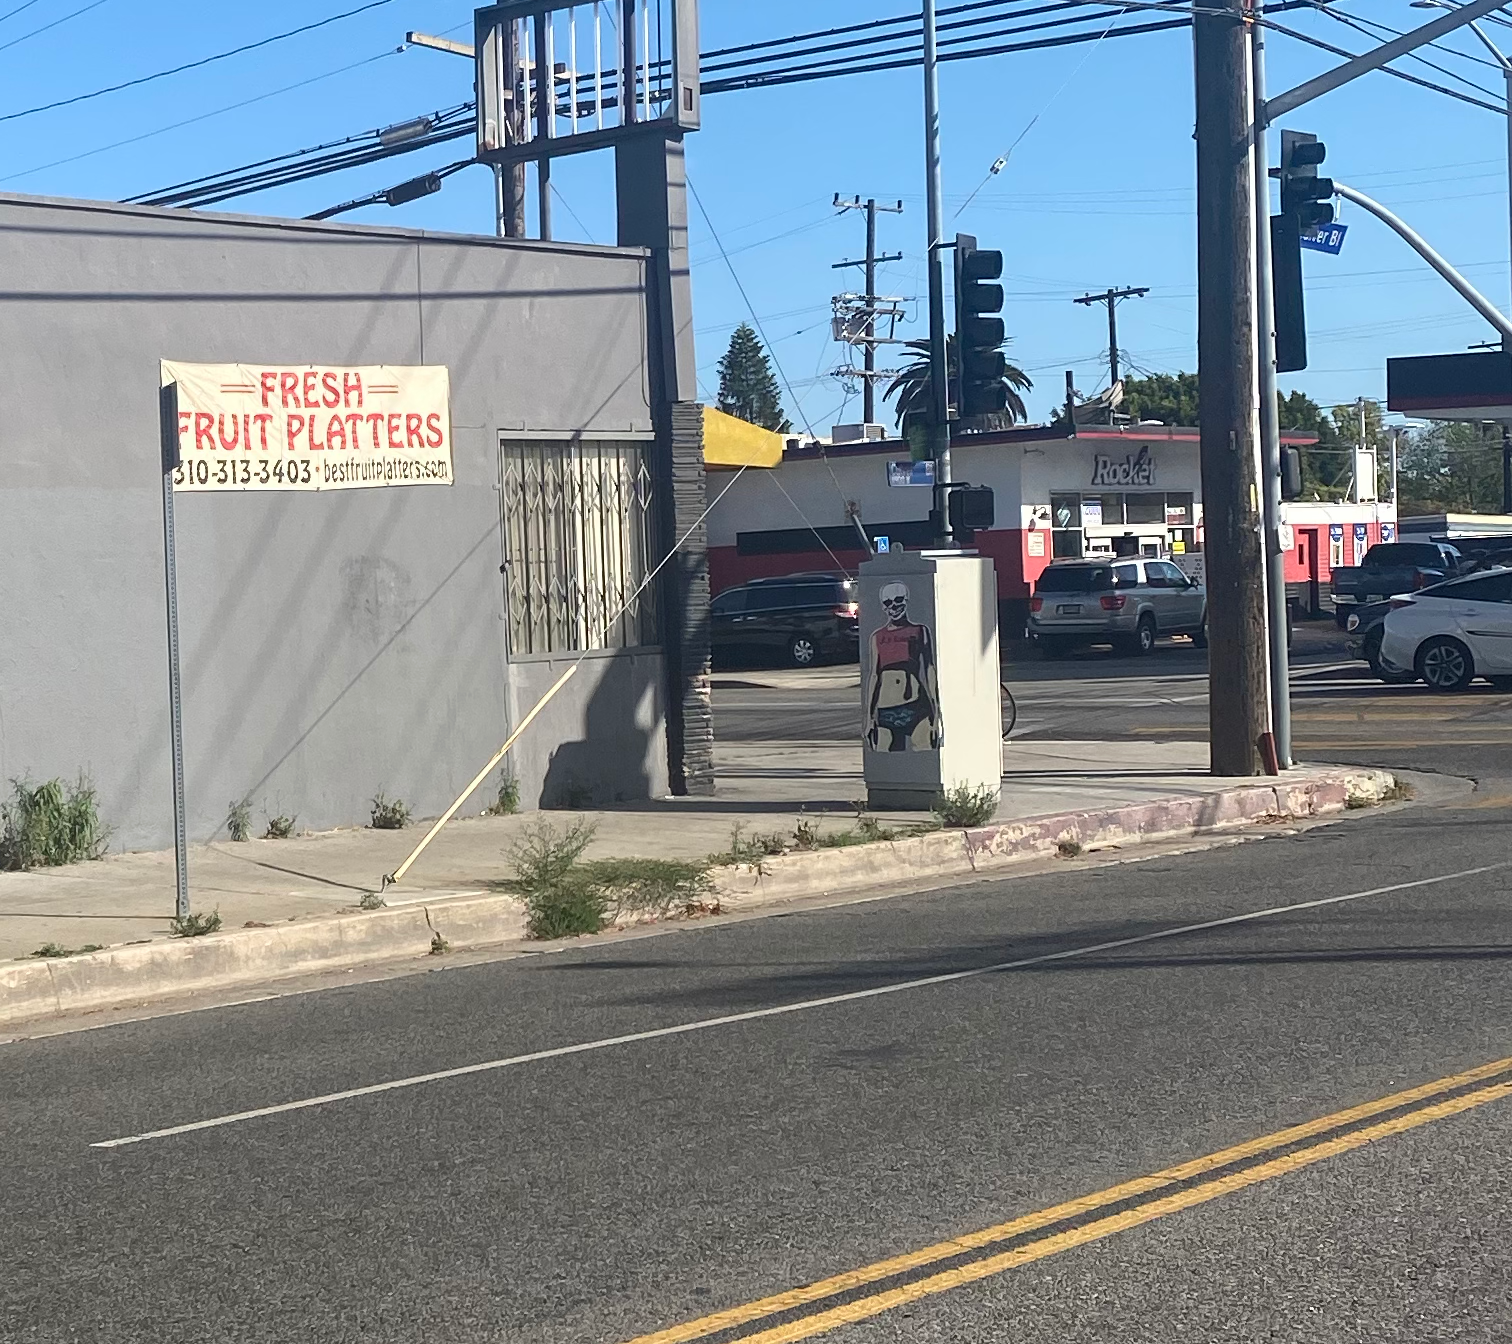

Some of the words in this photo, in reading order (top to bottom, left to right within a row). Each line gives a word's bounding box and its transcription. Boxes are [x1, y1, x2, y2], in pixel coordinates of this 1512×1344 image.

[260, 371, 363, 409] FRESH
[178, 412, 273, 451] FRUIT
[287, 413, 443, 451] PLATTERS
[174, 459, 311, 485] 310-313-3403
[323, 456, 448, 483] bestfruitplatters.com
[1092, 453, 1156, 486] Rocket
